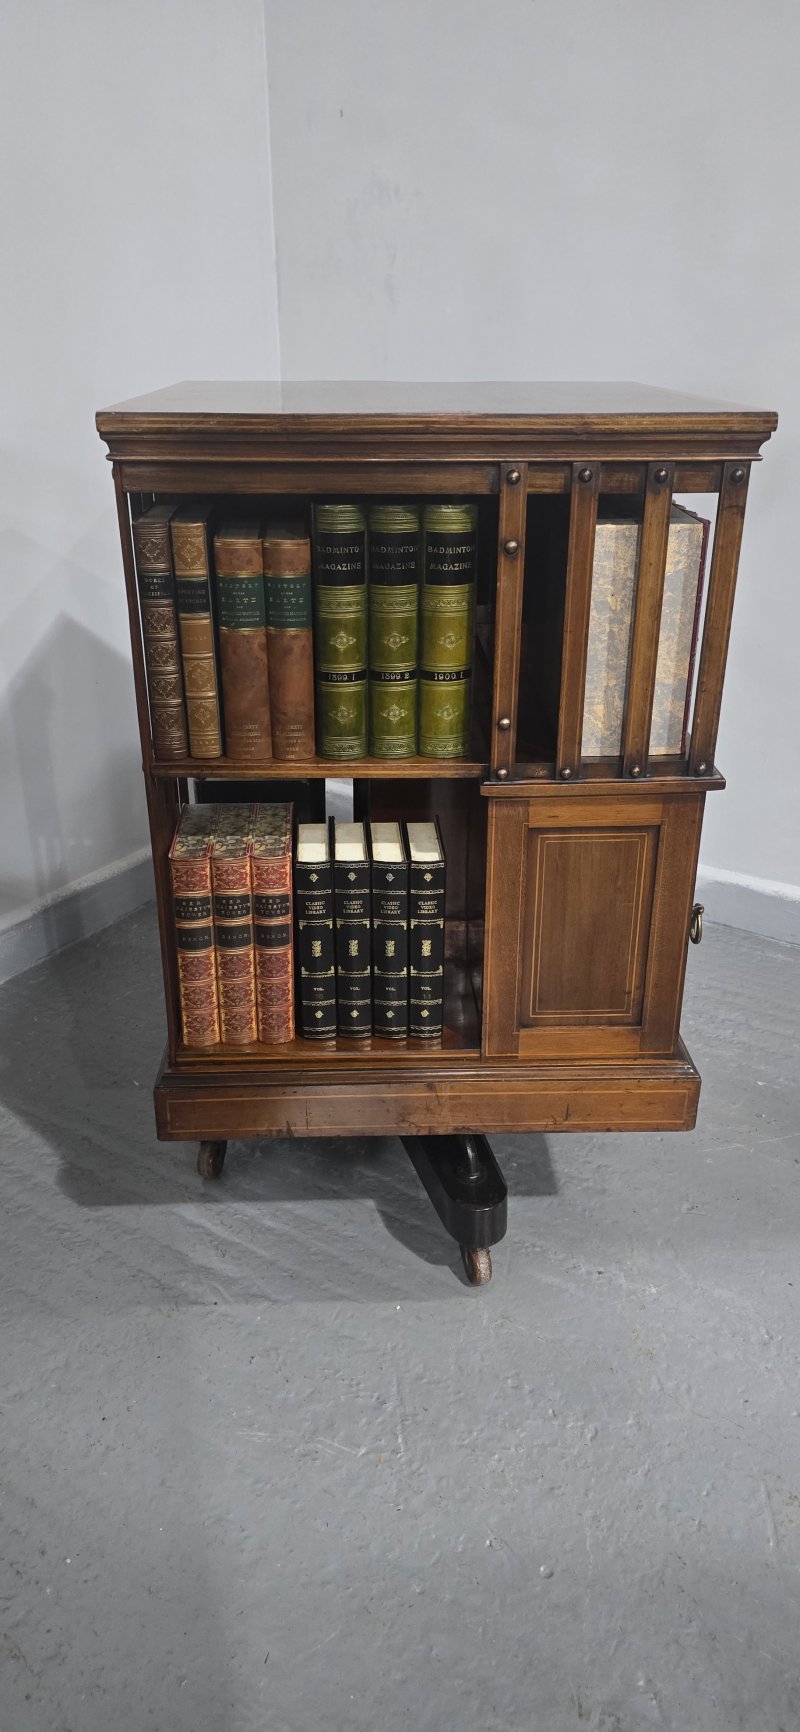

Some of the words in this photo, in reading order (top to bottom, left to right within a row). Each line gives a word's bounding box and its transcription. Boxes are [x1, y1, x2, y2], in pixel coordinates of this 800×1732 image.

[429, 562, 472, 570] MAGAZINE
[328, 673, 348, 681] 1899
[434, 672, 456, 680] 1900
